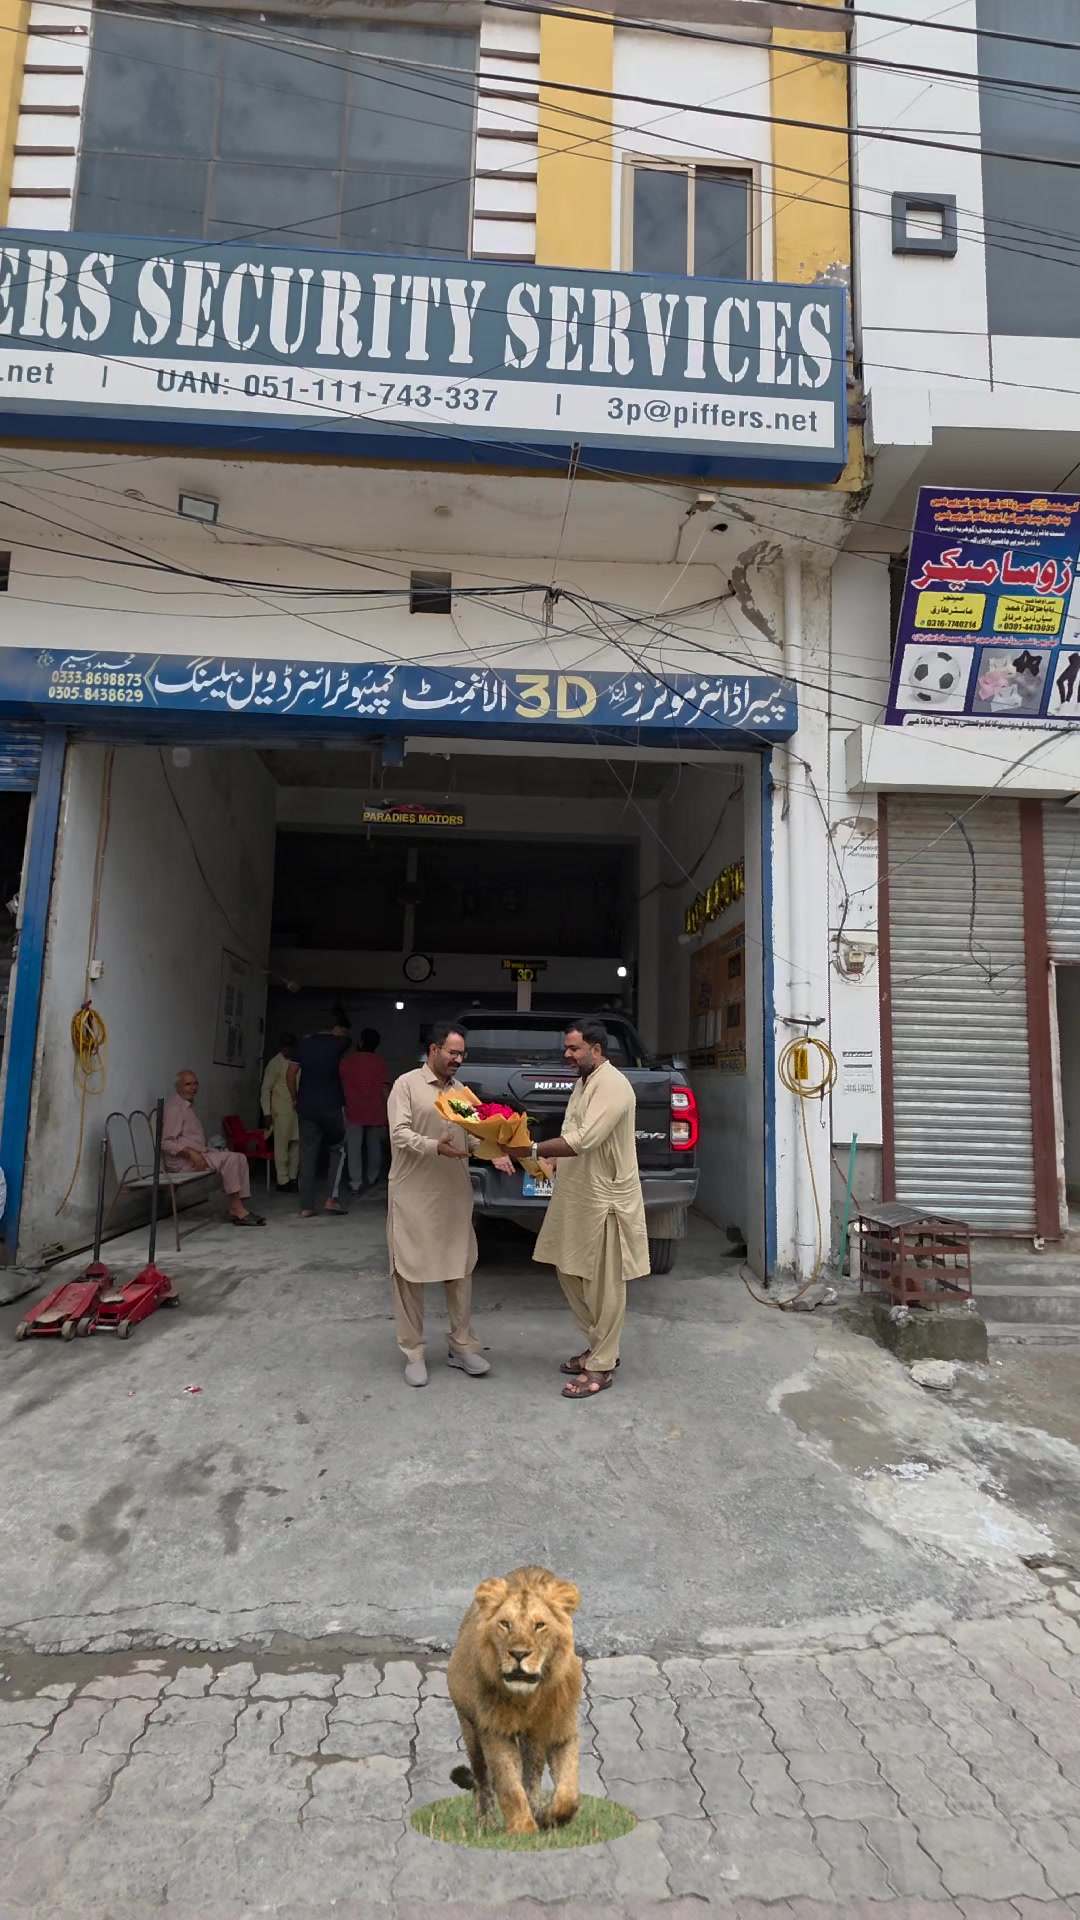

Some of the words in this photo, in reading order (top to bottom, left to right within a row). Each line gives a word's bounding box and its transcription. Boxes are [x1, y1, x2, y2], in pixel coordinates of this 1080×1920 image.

[132, 256, 486, 365] SECURITY
[504, 282, 833, 389] SERVICES
[156, 368, 231, 396] UAN:
[244, 373, 499, 413] 051-111-743-337
[607, 395, 818, 434] 3p@piffers.net
[515, 674, 598, 720] 3D
[363, 811, 416, 824] PARADIES
[418, 814, 464, 825] MOTORS
[534, 1081, 574, 1091] HILUX
